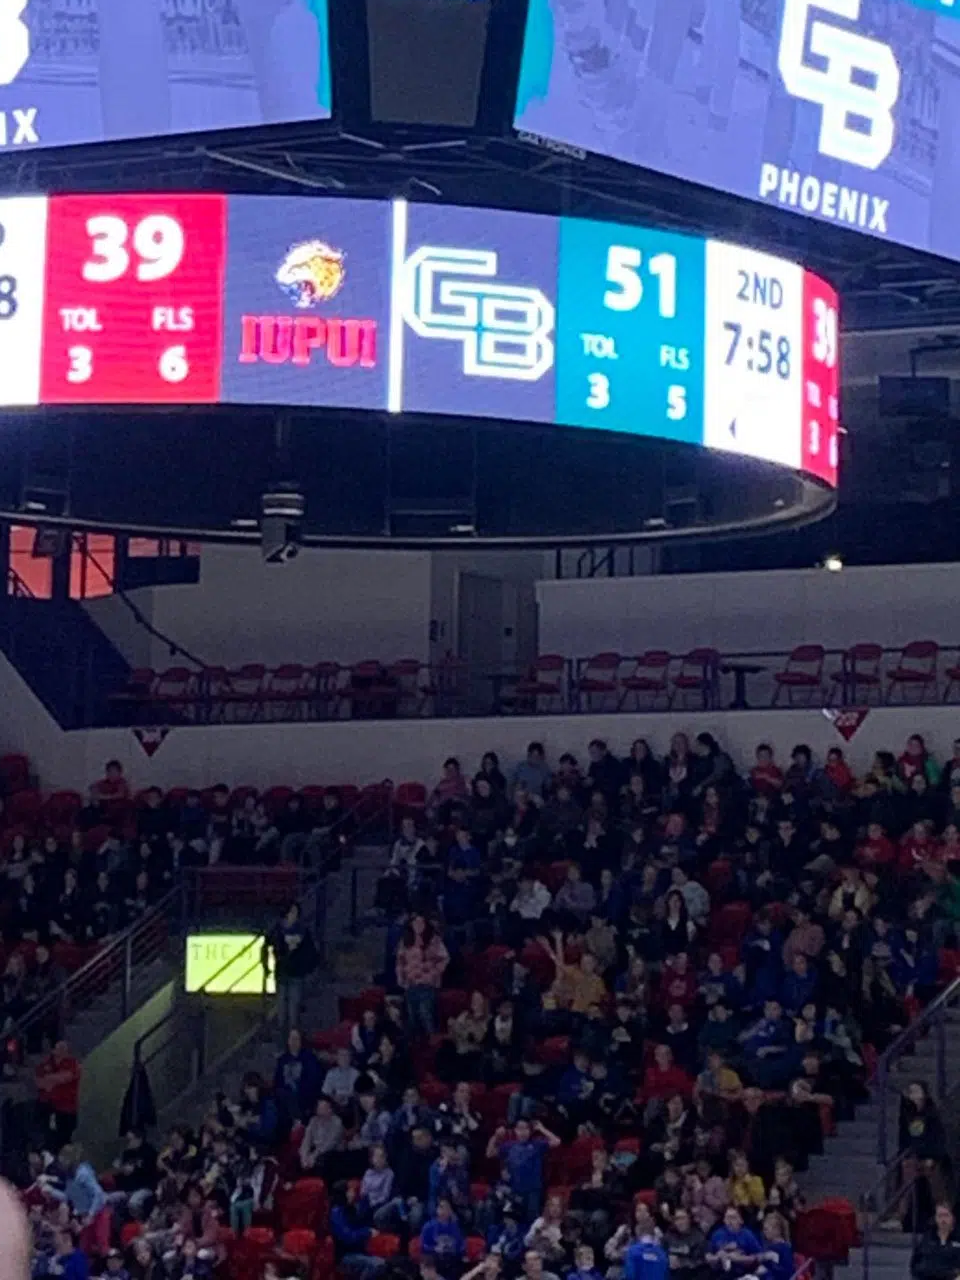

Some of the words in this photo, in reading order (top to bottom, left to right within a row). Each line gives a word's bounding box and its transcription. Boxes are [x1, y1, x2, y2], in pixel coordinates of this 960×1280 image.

[759, 164, 891, 233] PHOENIX
[82, 216, 184, 282] 39
[603, 245, 678, 318] 51
[736, 270, 783, 310] 2ND
[59, 307, 102, 333] TOL
[152, 306, 193, 331] FLS
[405, 246, 555, 380] GB
[239, 316, 377, 368] IUPUI
[581, 333, 618, 359] TOL
[660, 344, 689, 371] FLS
[723, 322, 791, 380] 7:58
[67, 345, 94, 384] 3
[159, 345, 188, 382] 6
[587, 373, 609, 409] 3
[667, 386, 687, 420] 5
